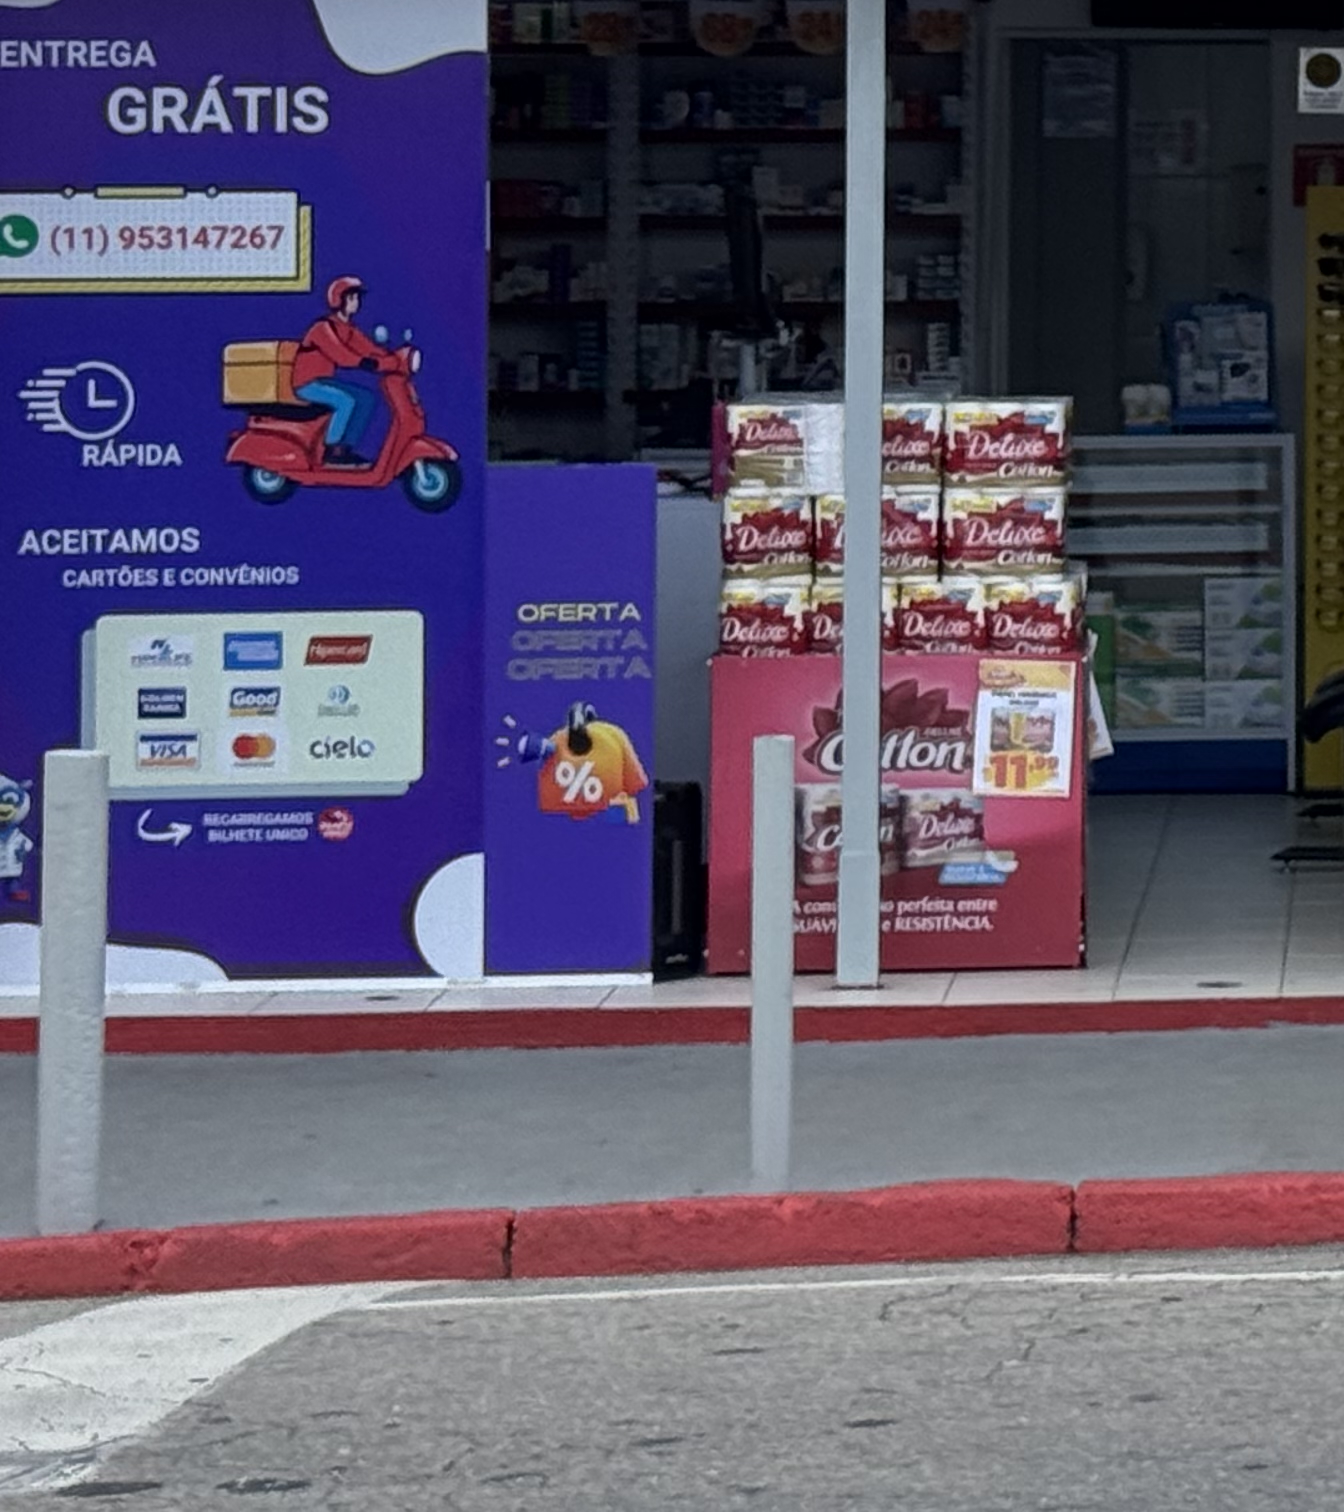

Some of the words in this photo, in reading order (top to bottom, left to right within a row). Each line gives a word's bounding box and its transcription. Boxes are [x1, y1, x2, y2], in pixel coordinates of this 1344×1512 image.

[0, 40, 157, 69] ENTREGA
[107, 74, 330, 135] GRÁTIS
[49, 224, 109, 257] (11)
[118, 224, 286, 252] 953147267
[81, 438, 182, 467] RÁPIDA
[882, 434, 931, 457] eluxe
[965, 430, 1047, 459] Deluxe
[999, 461, 1054, 478] Cotton
[17, 528, 201, 555] ACEITAMOS
[735, 526, 807, 551] Deluxe
[965, 516, 1046, 546] Deluxe
[998, 549, 1053, 566] Cotton
[62, 566, 160, 588] CARTÕES
[163, 568, 176, 586] E
[180, 562, 300, 587] CONVÊNIOS
[517, 602, 641, 622] OFERTA
[903, 611, 972, 637] Deluxe
[992, 612, 1059, 637] Deluxe
[511, 628, 648, 652] OFERTA
[722, 617, 789, 644] Deluxe
[507, 655, 652, 680] OFERTA
[232, 689, 278, 706] Good
[149, 742, 188, 759] VISA
[309, 735, 376, 760] cielo
[819, 729, 967, 772] Ctton
[956, 898, 998, 913] entre
